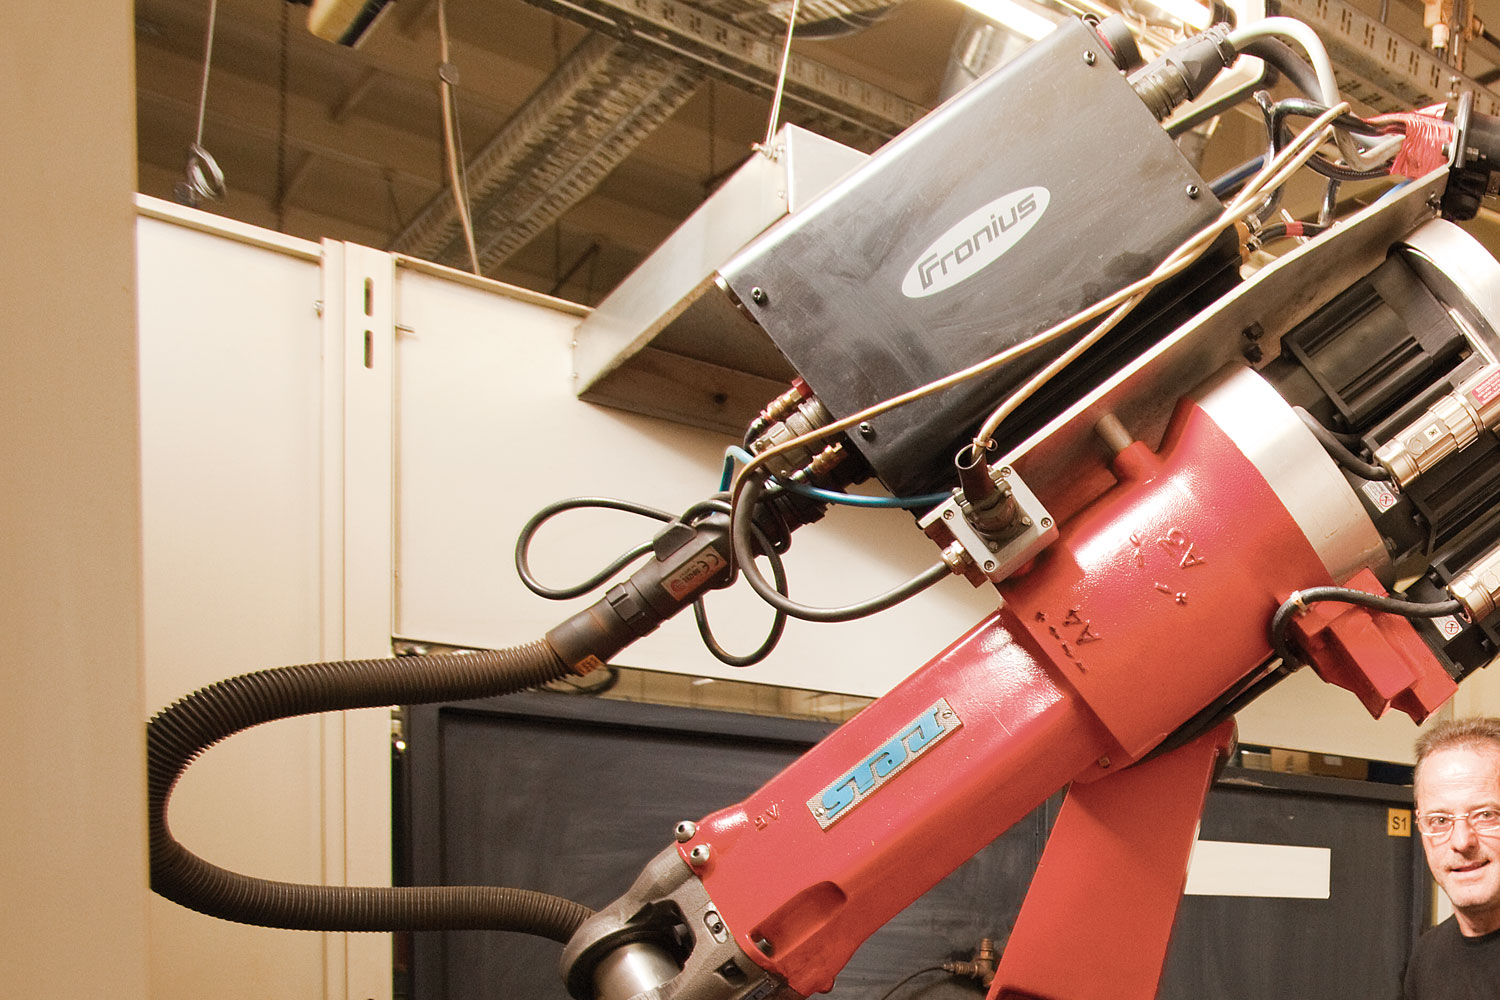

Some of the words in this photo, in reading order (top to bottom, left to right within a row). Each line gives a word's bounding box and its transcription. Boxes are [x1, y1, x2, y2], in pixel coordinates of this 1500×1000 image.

[918, 193, 1037, 290] Fronius
[1062, 609, 1102, 646] A4
[1392, 816, 1407, 830] S1
